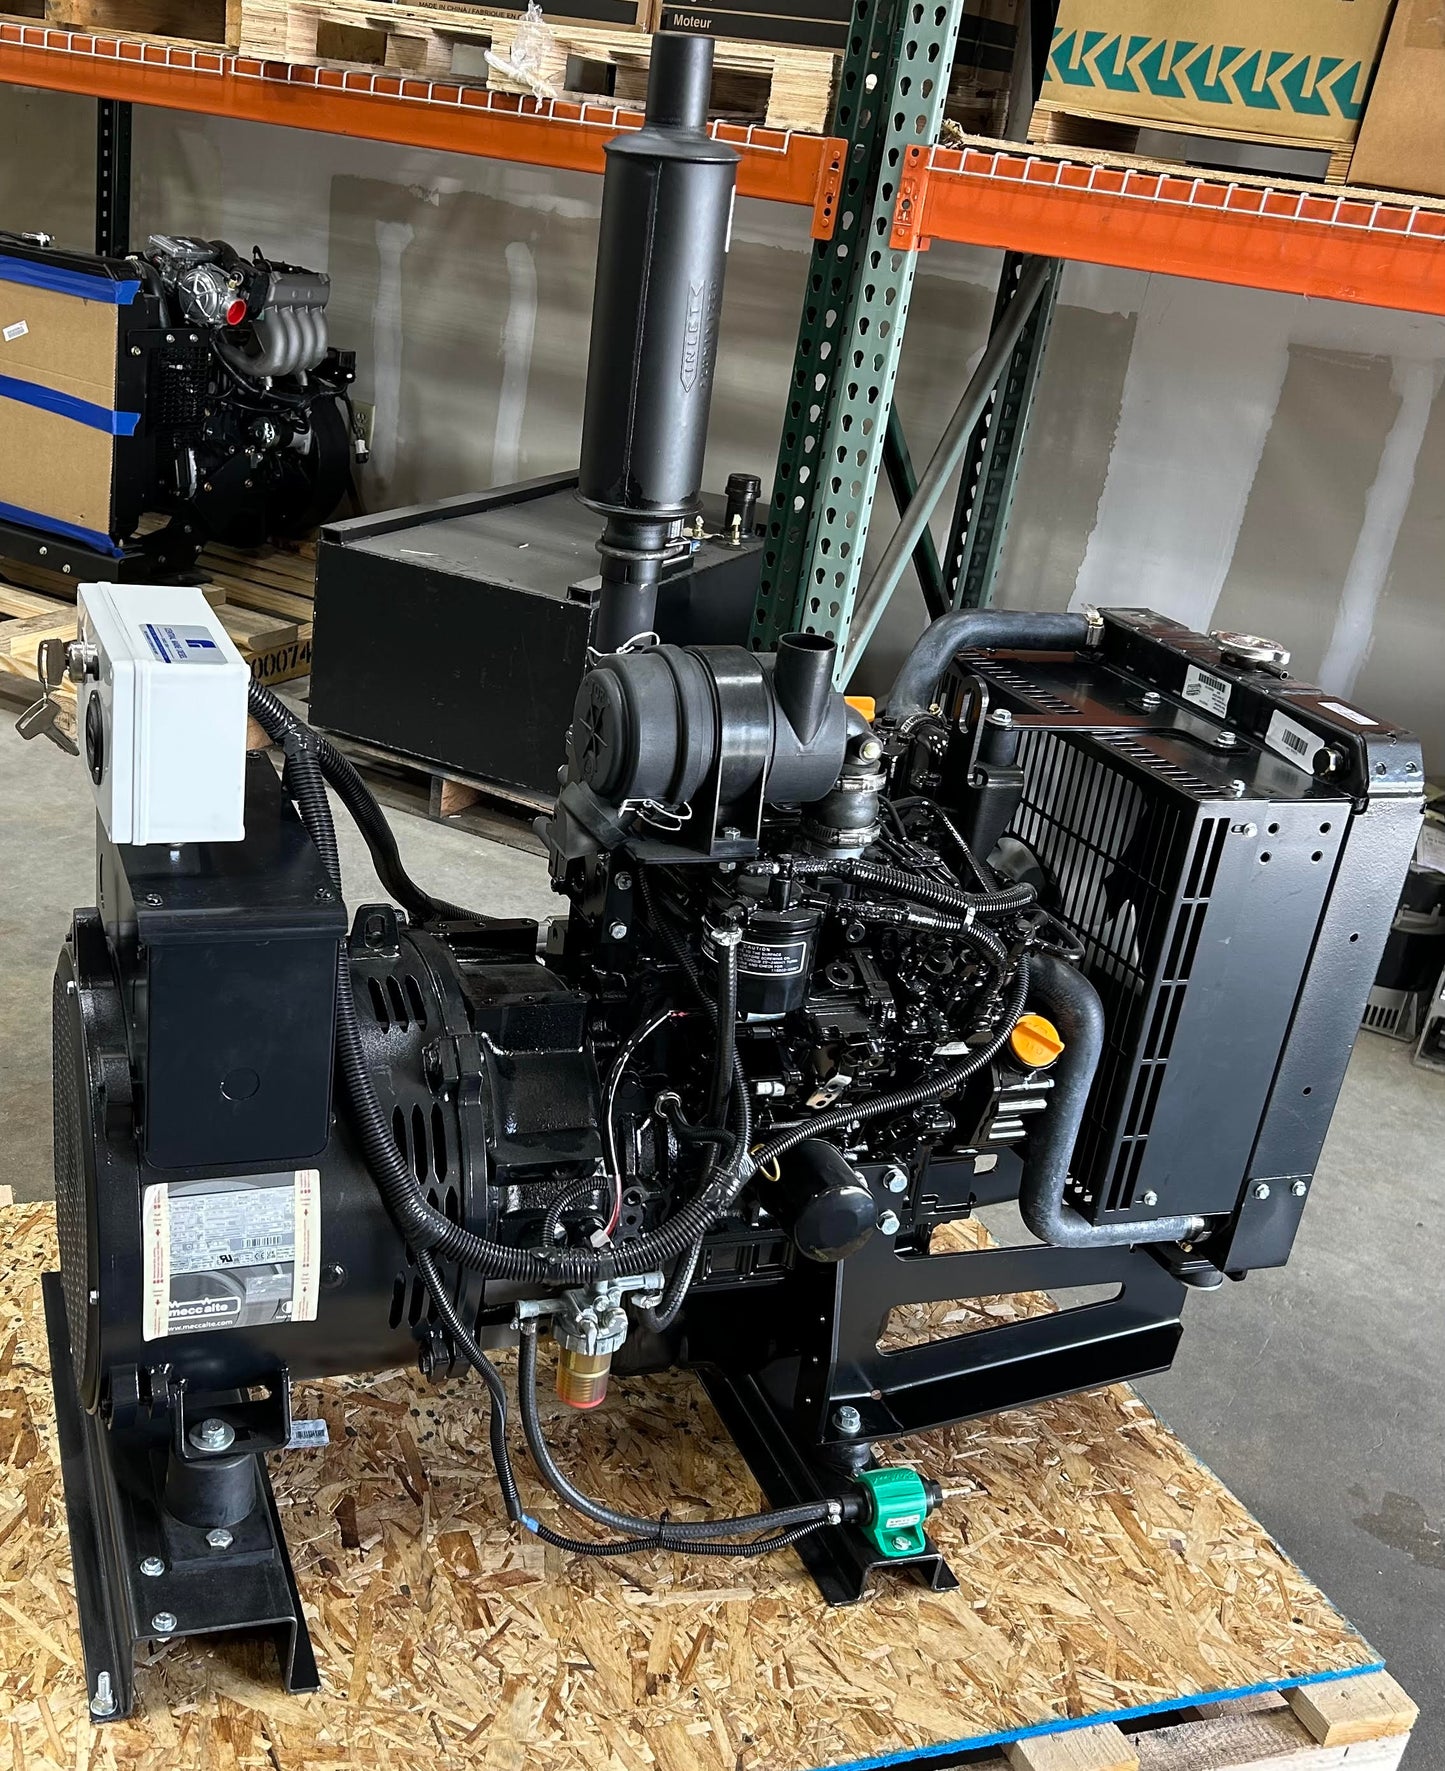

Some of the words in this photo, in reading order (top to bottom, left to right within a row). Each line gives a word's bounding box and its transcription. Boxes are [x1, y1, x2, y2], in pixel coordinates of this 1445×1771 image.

[447, 5, 468, 13] CHINA
[471, 8, 505, 18] FABRIQUE
[673, 13, 712, 29] Moteur
[684, 306, 700, 373] INLET
